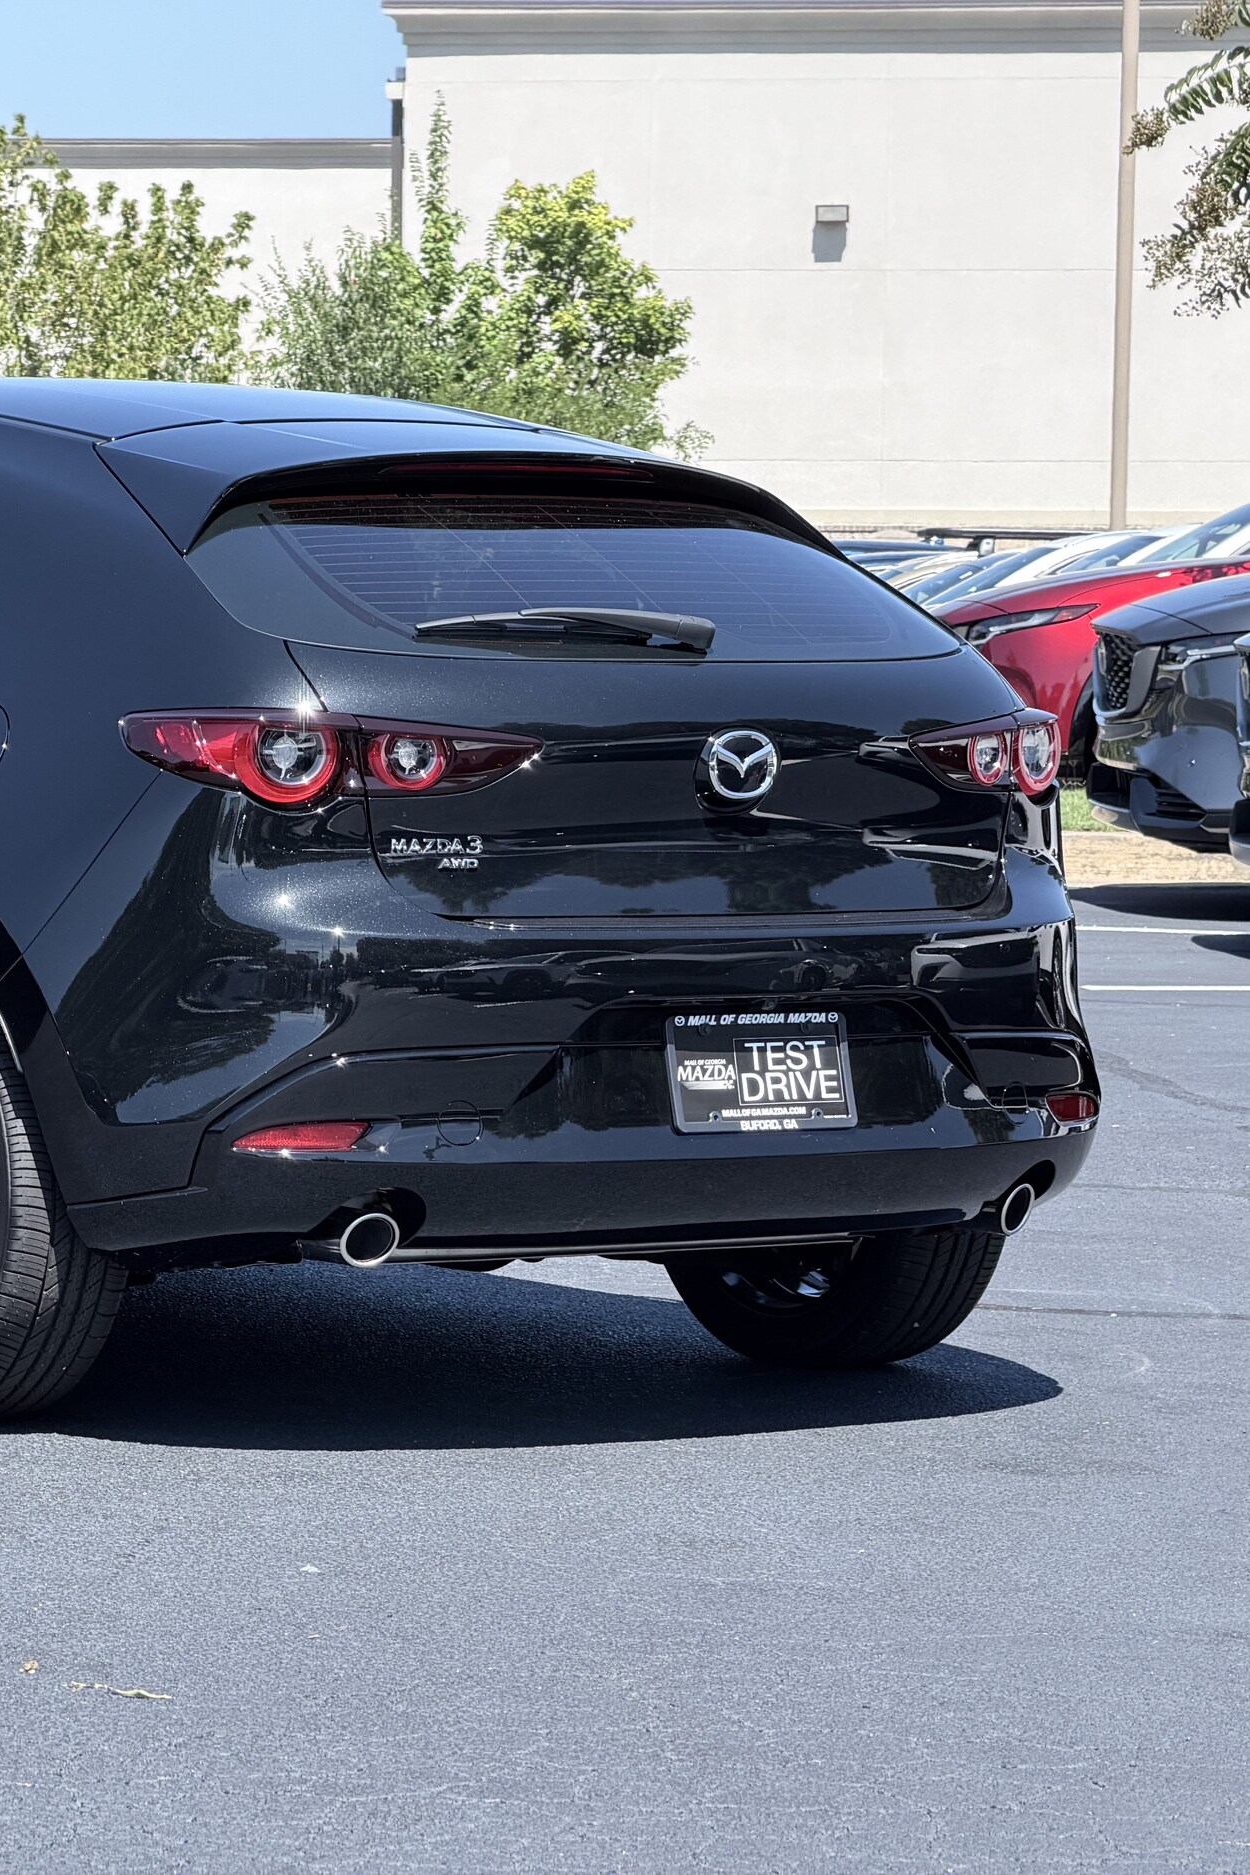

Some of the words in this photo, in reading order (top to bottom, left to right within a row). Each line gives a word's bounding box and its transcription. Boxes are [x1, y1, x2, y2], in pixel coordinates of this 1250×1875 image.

[437, 858, 479, 869] AWD
[687, 1014, 717, 1027] MALL
[720, 1014, 736, 1025] OF
[737, 1013, 785, 1025] GEORGIA
[787, 1012, 826, 1024] MAZDA
[744, 1041, 825, 1071] TEST
[677, 1064, 736, 1082] MAZDA
[741, 1069, 840, 1102] DRIVE
[783, 1119, 799, 1130] GA
